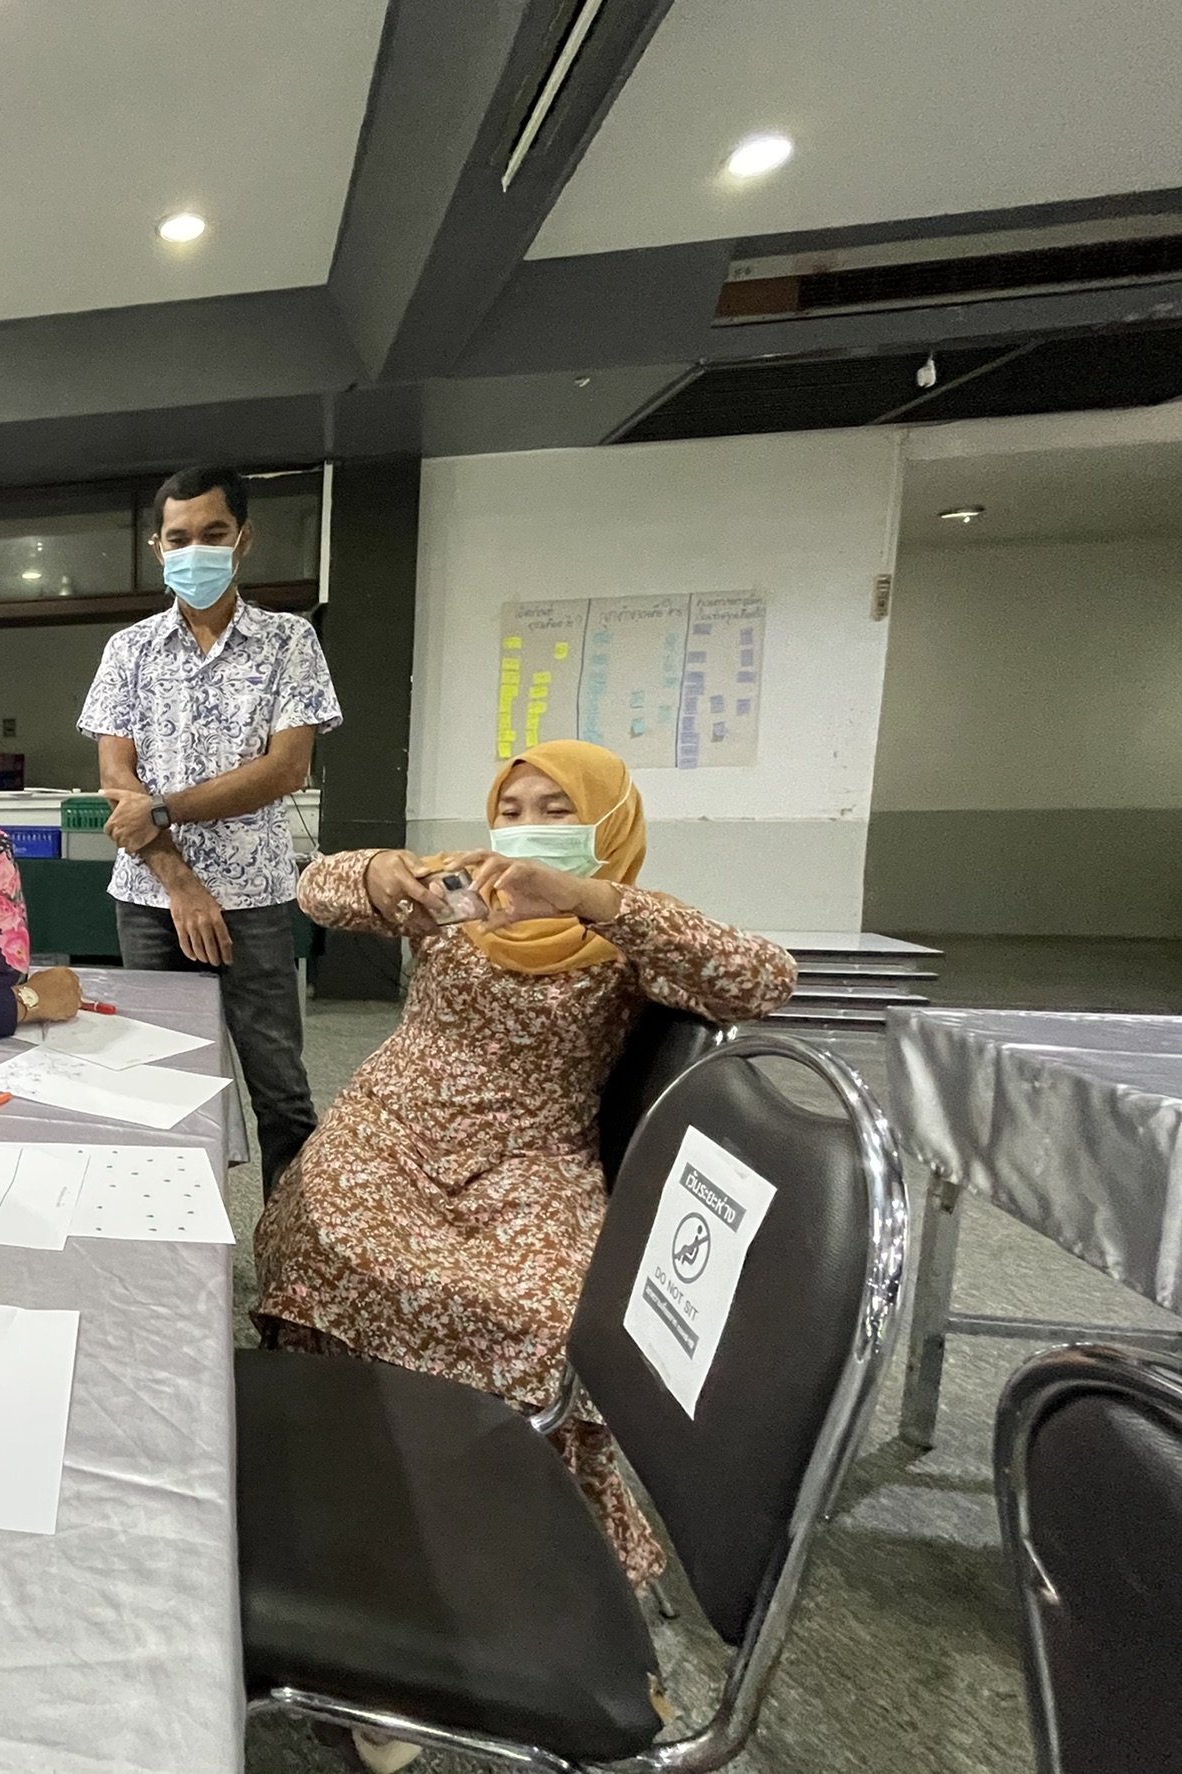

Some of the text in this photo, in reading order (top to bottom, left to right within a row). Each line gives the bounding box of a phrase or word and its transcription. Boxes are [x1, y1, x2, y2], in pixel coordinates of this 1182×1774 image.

[685, 1170, 736, 1224] เว้นระยะห่าง
[654, 1266, 699, 1321] DO NOT SIT
